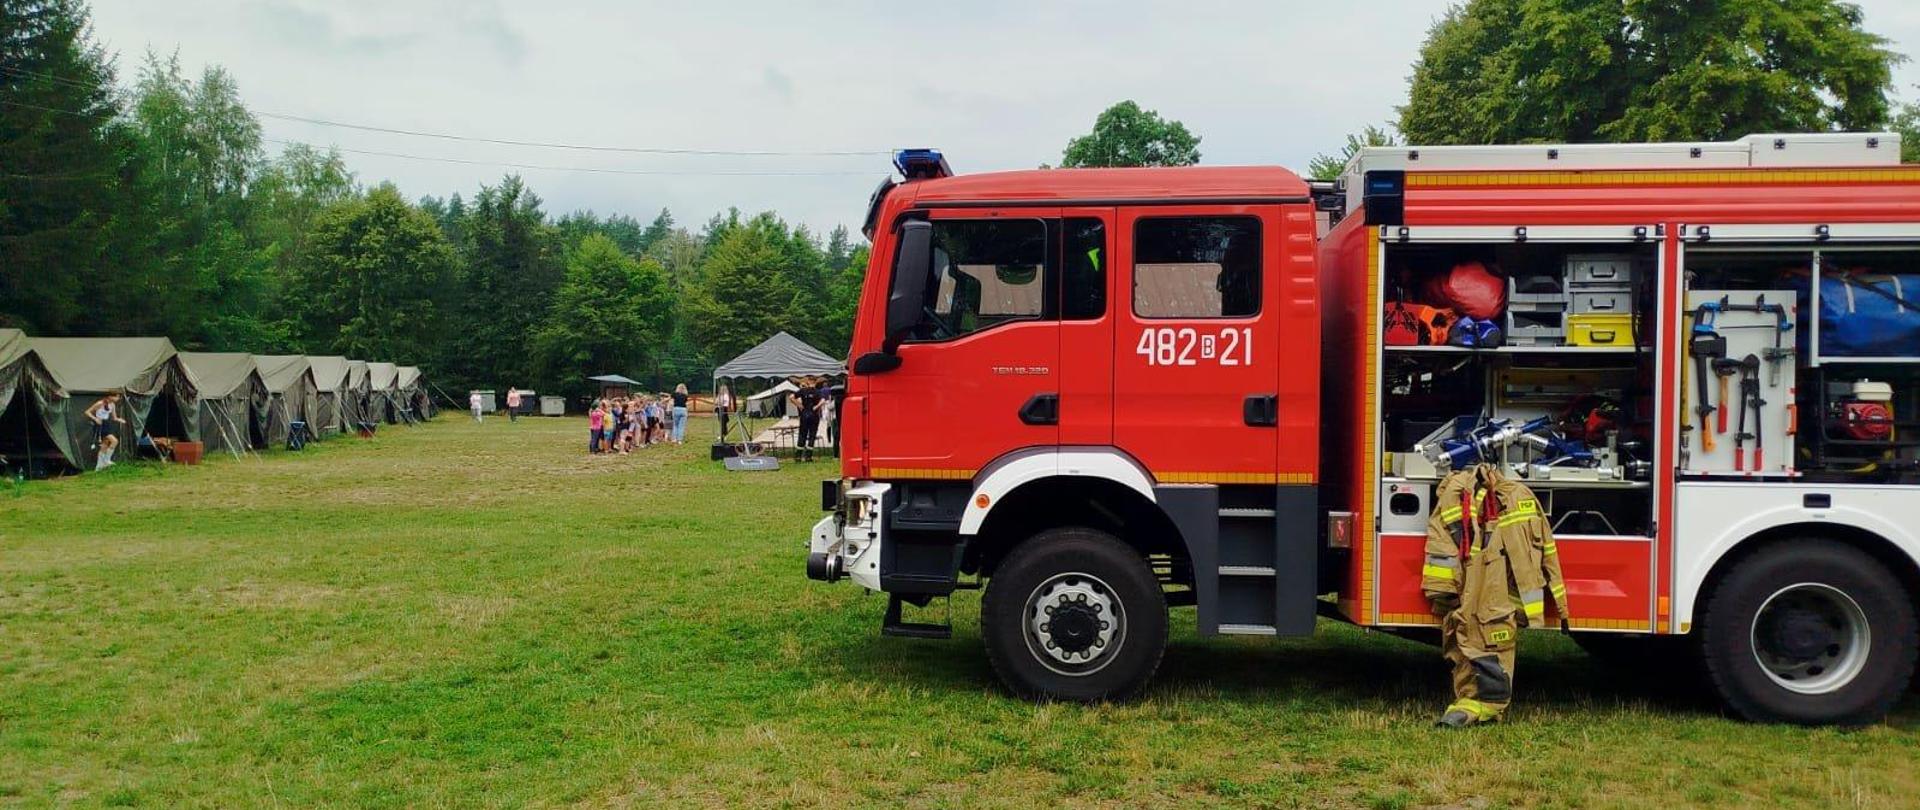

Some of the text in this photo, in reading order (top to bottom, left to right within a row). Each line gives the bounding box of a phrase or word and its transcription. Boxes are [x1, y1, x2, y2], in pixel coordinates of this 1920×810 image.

[1136, 327, 1252, 366] 482 B 21
